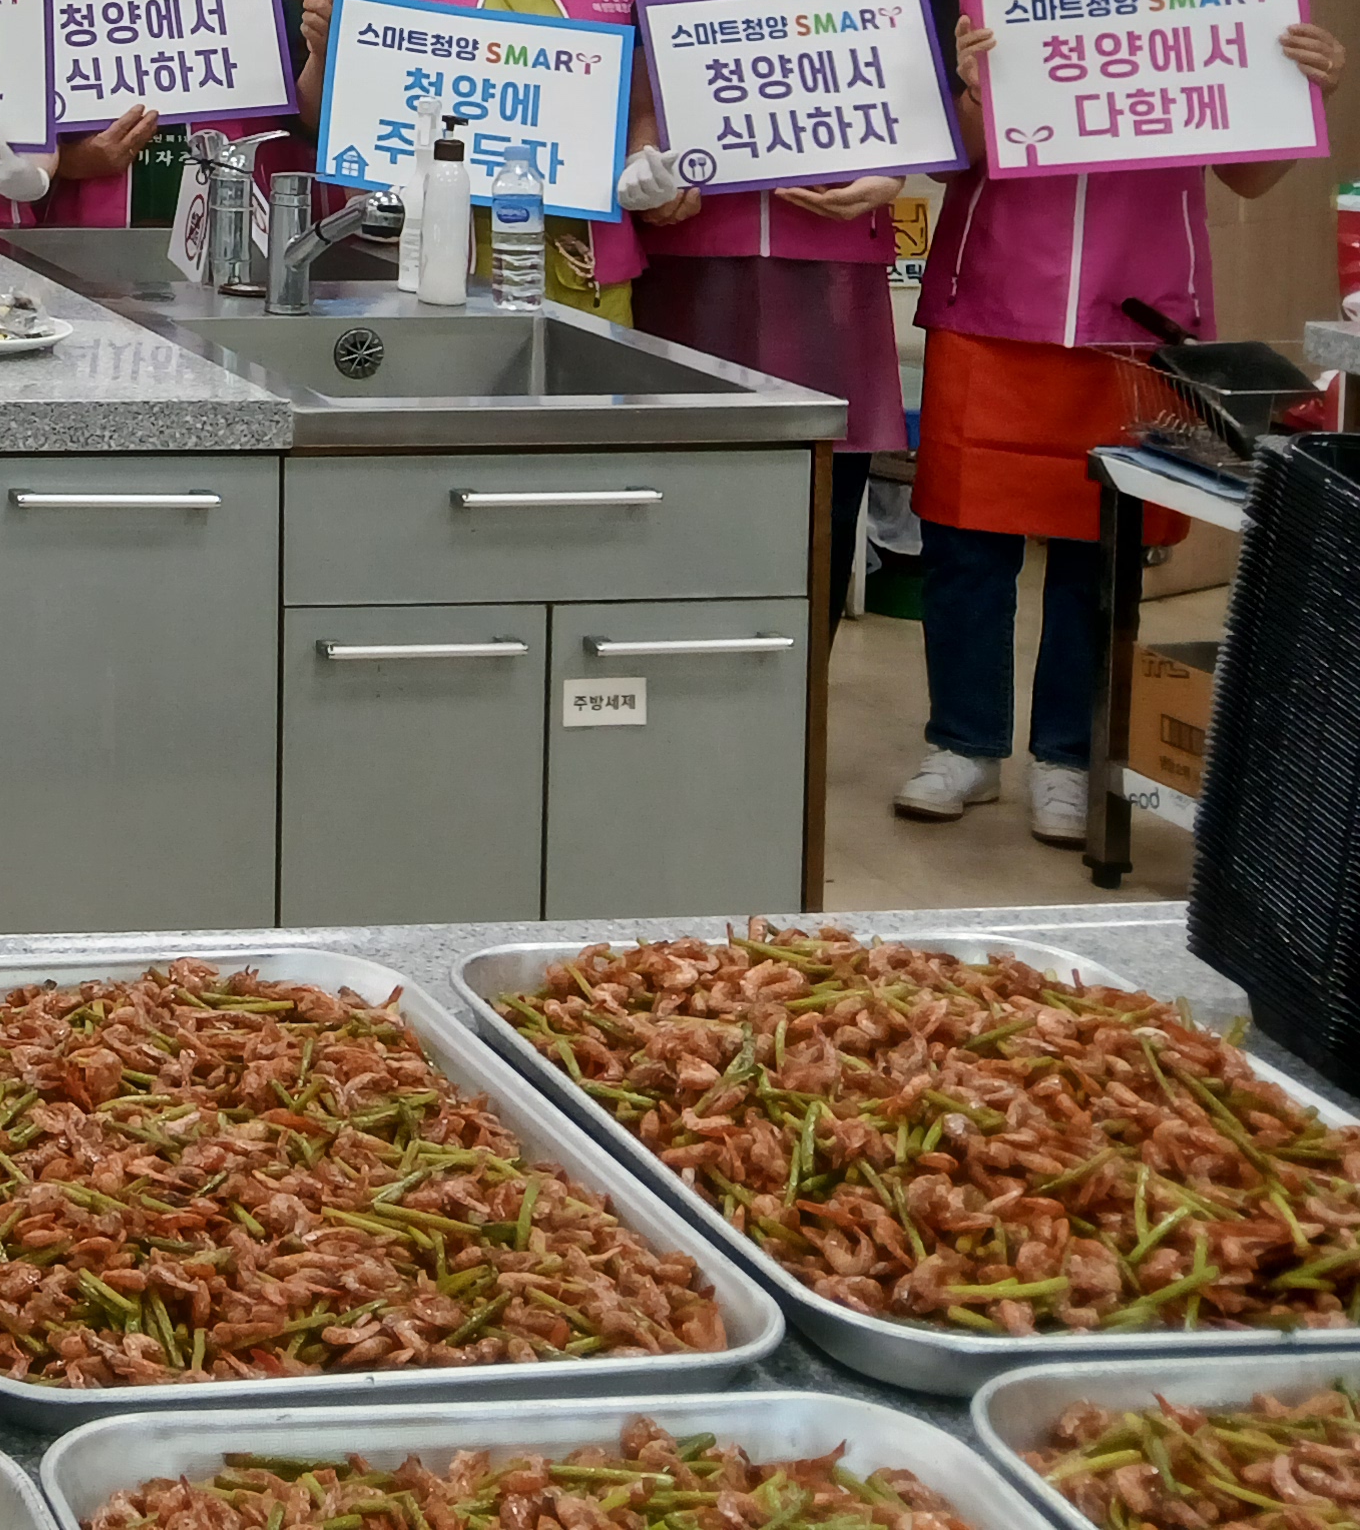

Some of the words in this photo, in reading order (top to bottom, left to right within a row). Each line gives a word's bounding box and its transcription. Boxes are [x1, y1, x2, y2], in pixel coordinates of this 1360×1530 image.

[356, 21, 479, 63] 스마트청양
[670, 15, 789, 50] 스마트청양
[1042, 21, 1250, 84] 청양에서
[65, 47, 238, 101] 식사하자
[402, 66, 543, 129] 청양에
[704, 45, 888, 105] 청양에서
[715, 100, 900, 161] 식사하자
[1075, 82, 1231, 140] 다함께
[375, 118, 566, 187] 주두자
[573, 693, 637, 712] 주방세제
